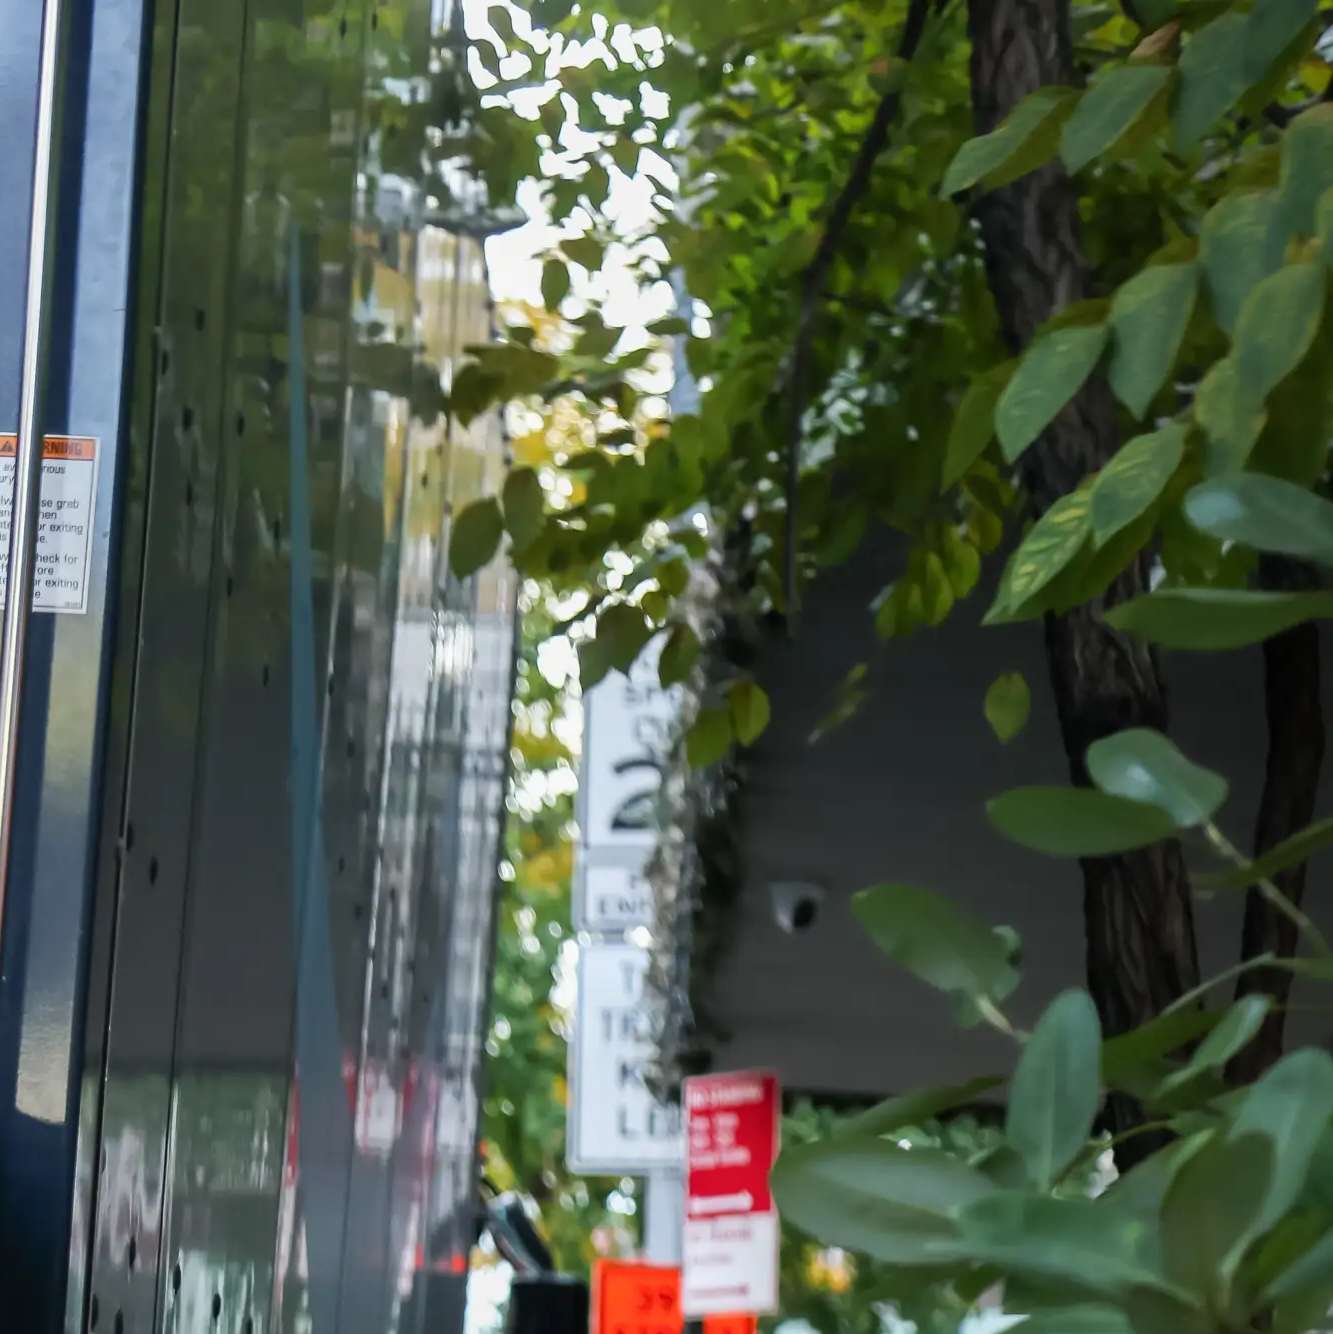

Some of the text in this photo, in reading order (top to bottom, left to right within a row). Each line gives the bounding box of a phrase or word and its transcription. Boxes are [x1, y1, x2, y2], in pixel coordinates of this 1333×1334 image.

[43, 441, 83, 454] RNING
[42, 465, 66, 474] rious
[40, 499, 53, 508] se
[56, 499, 80, 510] grab
[49, 522, 83, 535] exiting
[36, 552, 60, 564] heck
[64, 554, 79, 565] for
[45, 579, 79, 591] exiting
